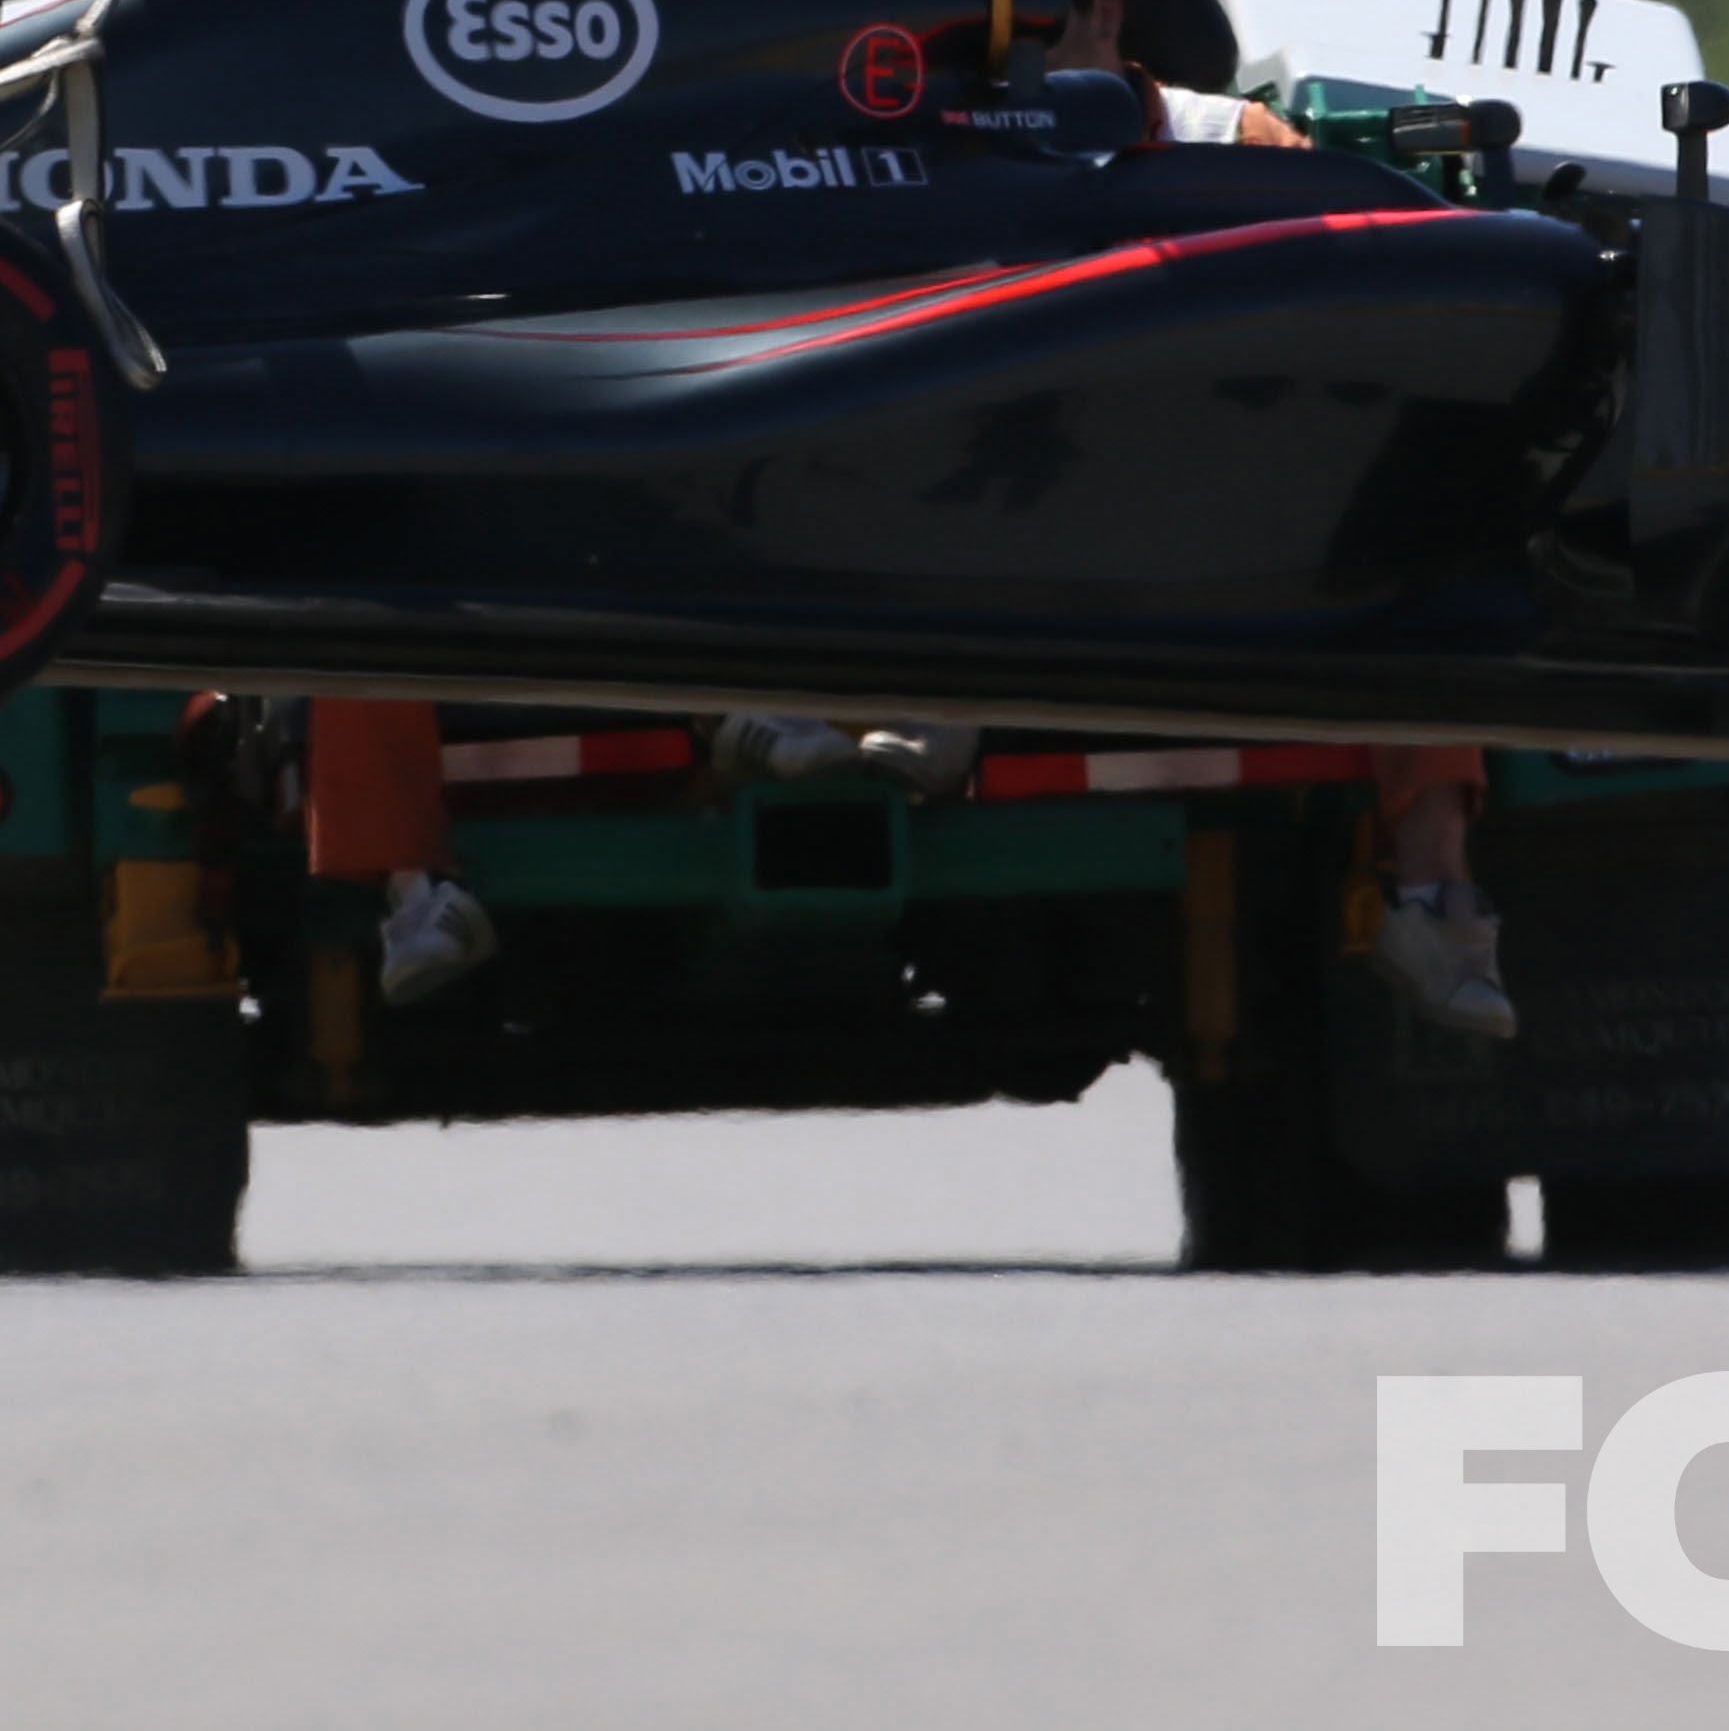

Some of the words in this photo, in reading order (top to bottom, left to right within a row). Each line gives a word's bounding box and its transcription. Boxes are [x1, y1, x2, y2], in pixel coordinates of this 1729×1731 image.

[971, 110, 1057, 129] BUTTON
[671, 147, 857, 195] Mobil
[875, 149, 908, 185] 1
[48, 347, 102, 553] PIRELLI
